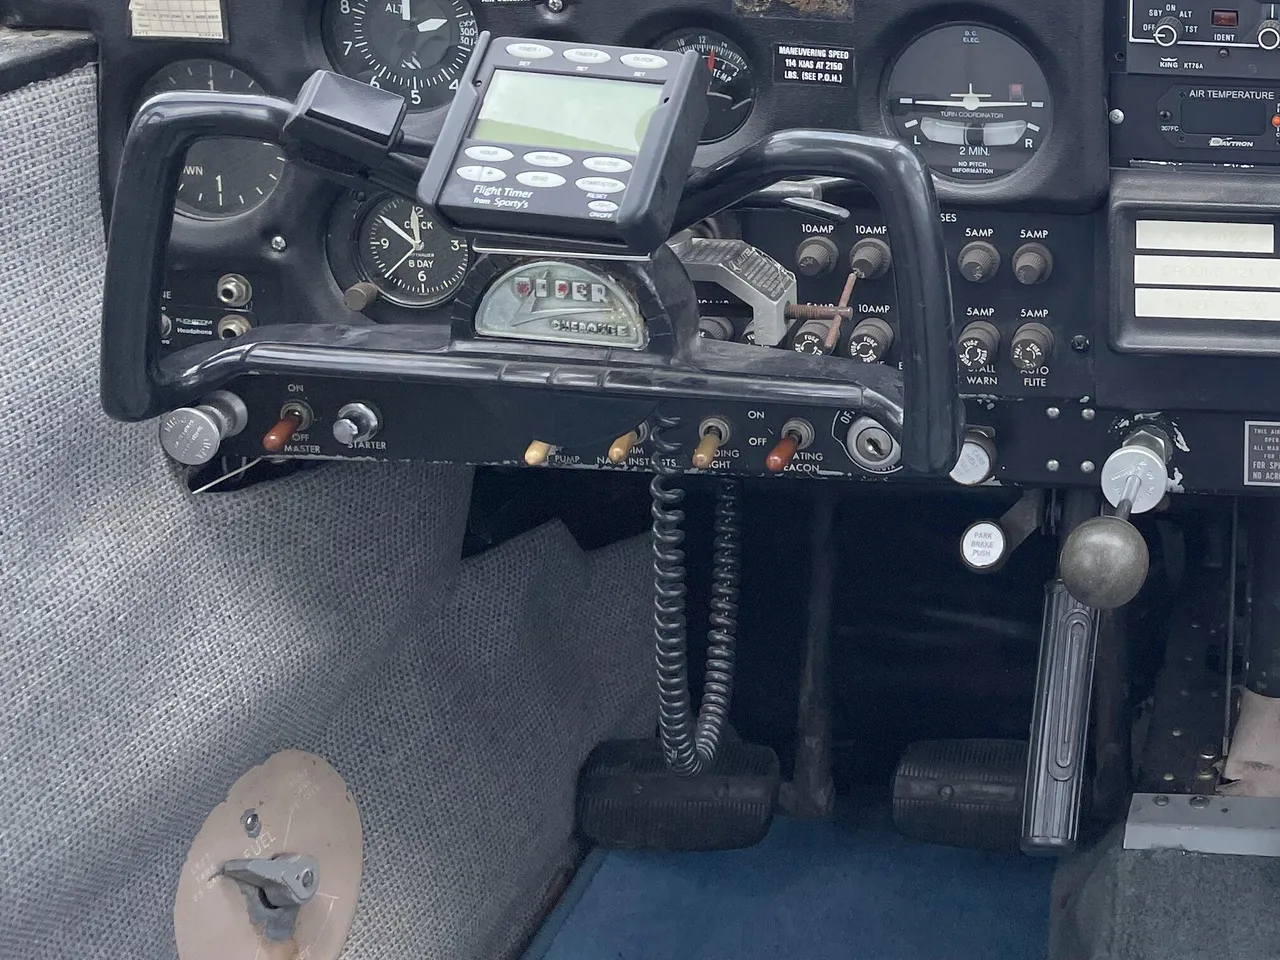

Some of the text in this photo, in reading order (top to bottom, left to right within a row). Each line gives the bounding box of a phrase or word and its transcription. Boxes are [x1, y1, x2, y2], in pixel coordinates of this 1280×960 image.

[1148, 9, 1162, 17] SBY
[1166, 4, 1176, 12] ON
[1179, 10, 1192, 18] ALT
[779, 46, 849, 60] MANEUVERING SPEED
[785, 58, 843, 71] 114 KIAS AT 2150
[784, 70, 842, 83] LBS. (SEE P.O.H.)
[1189, 90, 1274, 99] AIR TEMPERATURE
[1209, 137, 1253, 147] DAVTRON
[959, 146, 990, 156] 2 MIN.
[952, 167, 993, 175] INFORMATION
[472, 185, 533, 199] Flight Timer
[473, 197, 529, 209] from Sporty's
[801, 223, 834, 234] 10AMP
[965, 227, 993, 237] 5AMP
[1020, 229, 1049, 239] 5AMP
[857, 304, 891, 314] 10AMP
[966, 376, 998, 386] WARN
[1023, 377, 1046, 387] FLITE
[284, 444, 320, 453] MASTER
[348, 441, 387, 450] STARTER
[974, 531, 992, 539] PARK
[971, 540, 994, 548] BRAKE
[972, 549, 991, 557] PUSH
